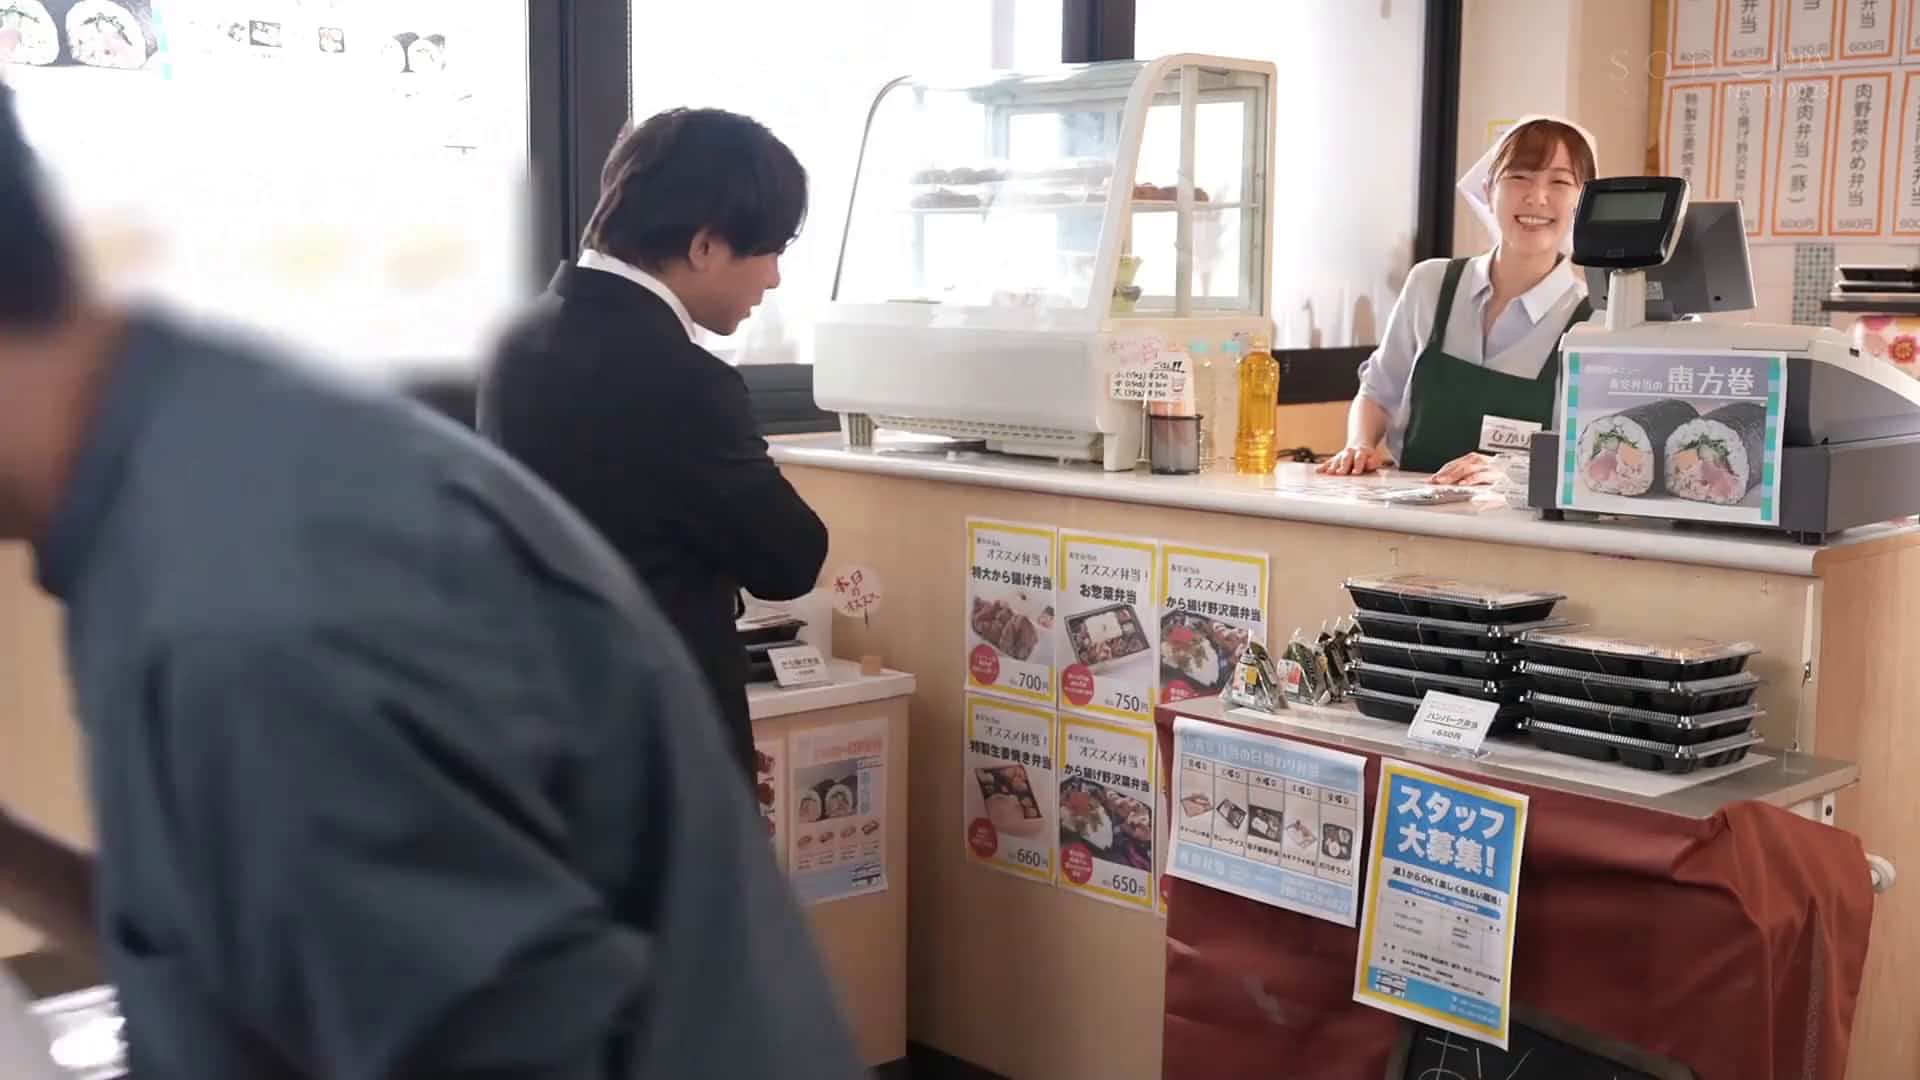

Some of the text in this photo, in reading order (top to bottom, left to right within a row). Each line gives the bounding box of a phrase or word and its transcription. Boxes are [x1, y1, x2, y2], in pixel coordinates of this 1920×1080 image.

[1848, 84, 1873, 207] 肉野菜炒め弁当
[1667, 365, 1755, 396] 恵方巻
[1490, 428, 1532, 446] ひかり
[1396, 784, 1505, 840] スタッフ
[1396, 822, 1497, 878] 大募集！
